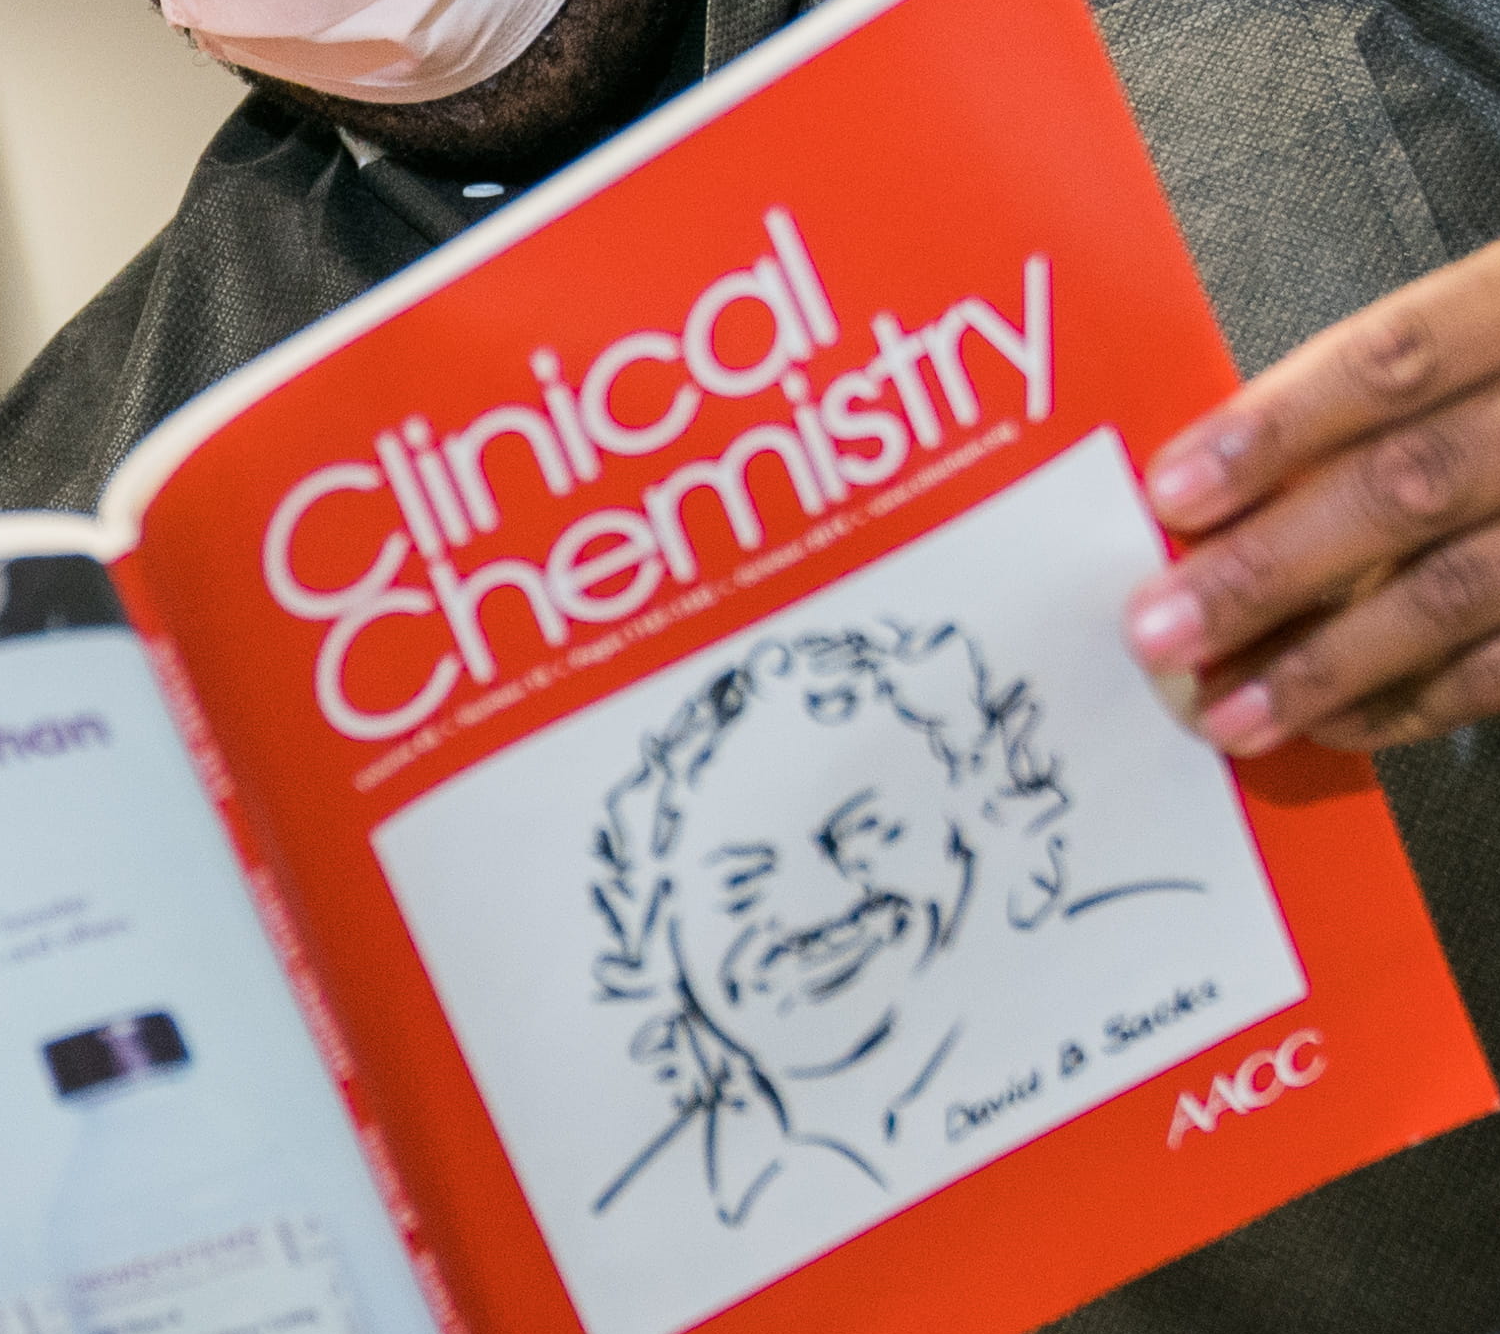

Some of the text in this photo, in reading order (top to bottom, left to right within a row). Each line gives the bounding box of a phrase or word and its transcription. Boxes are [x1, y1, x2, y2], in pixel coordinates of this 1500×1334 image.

[262, 207, 838, 619] Clinical
[314, 253, 1053, 741] Chemistry
[945, 1070, 1044, 1143] David
[1165, 1029, 1328, 1150] AACC
